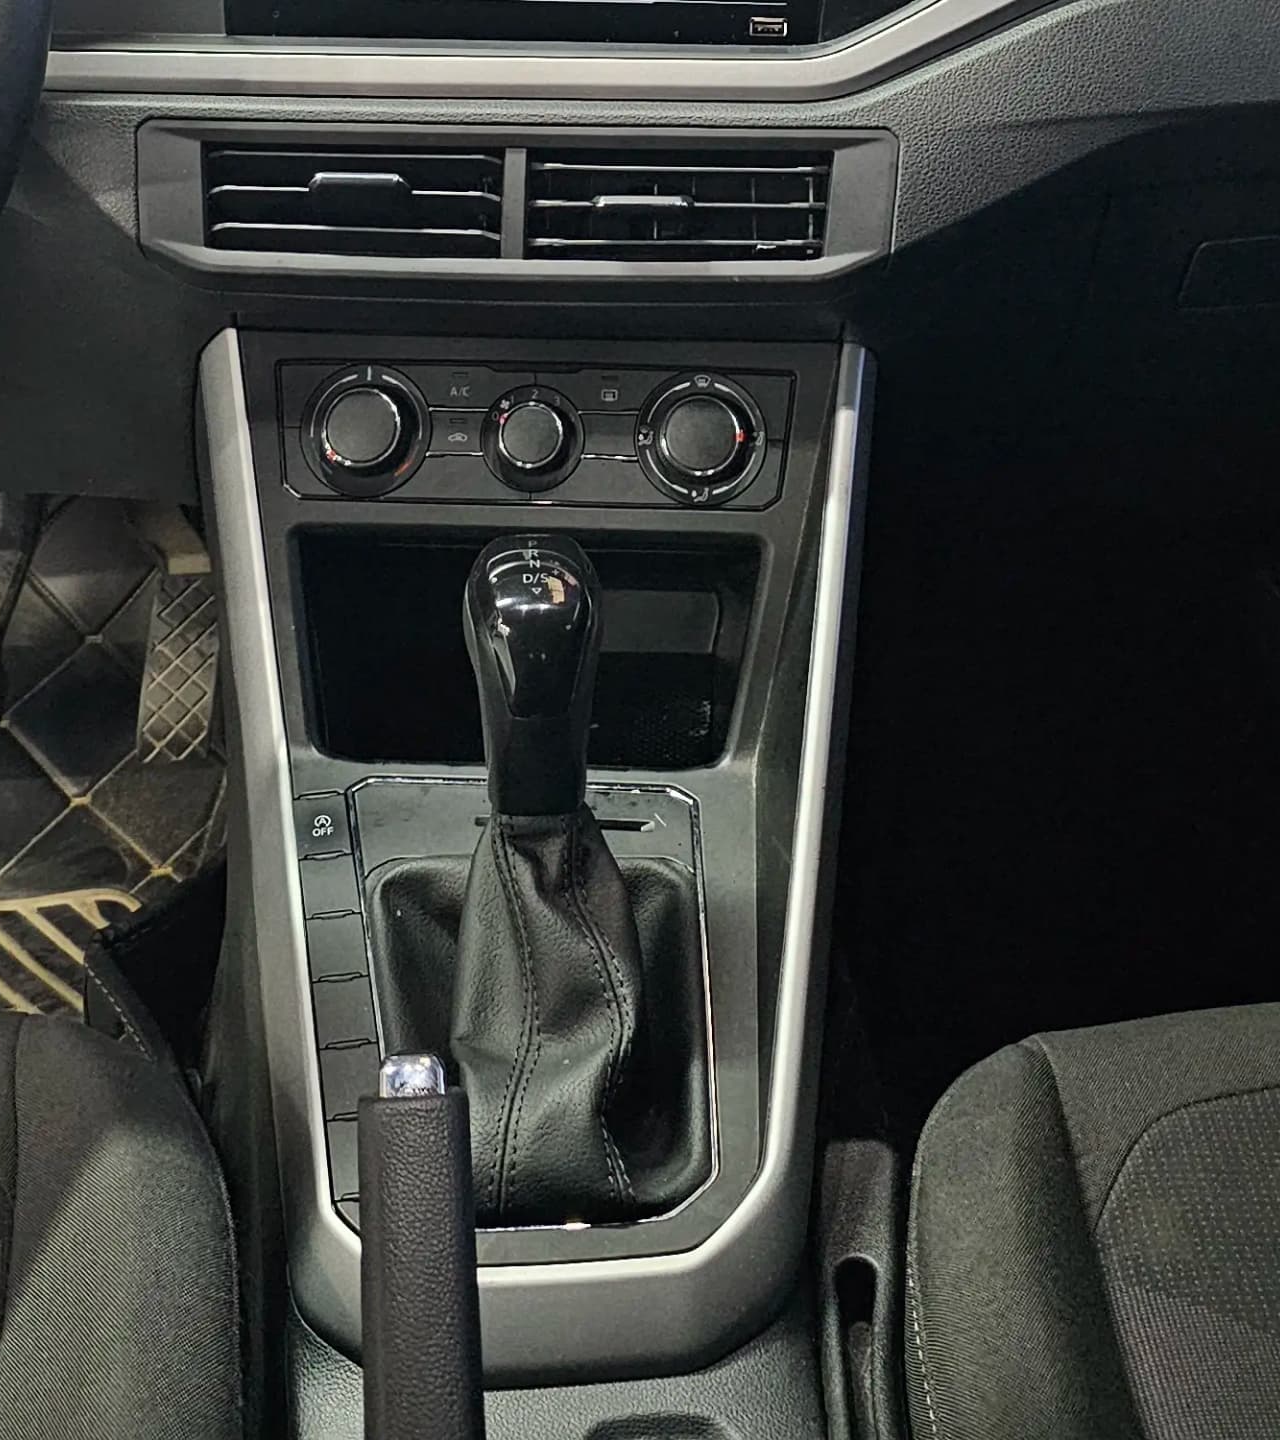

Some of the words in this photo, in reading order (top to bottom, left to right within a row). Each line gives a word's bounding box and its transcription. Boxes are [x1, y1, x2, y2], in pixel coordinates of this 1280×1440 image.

[450, 386, 470, 398] A/C
[532, 389, 539, 399] 2
[528, 549, 539, 557] R
[529, 559, 540, 568] N
[312, 826, 334, 837] OFF
